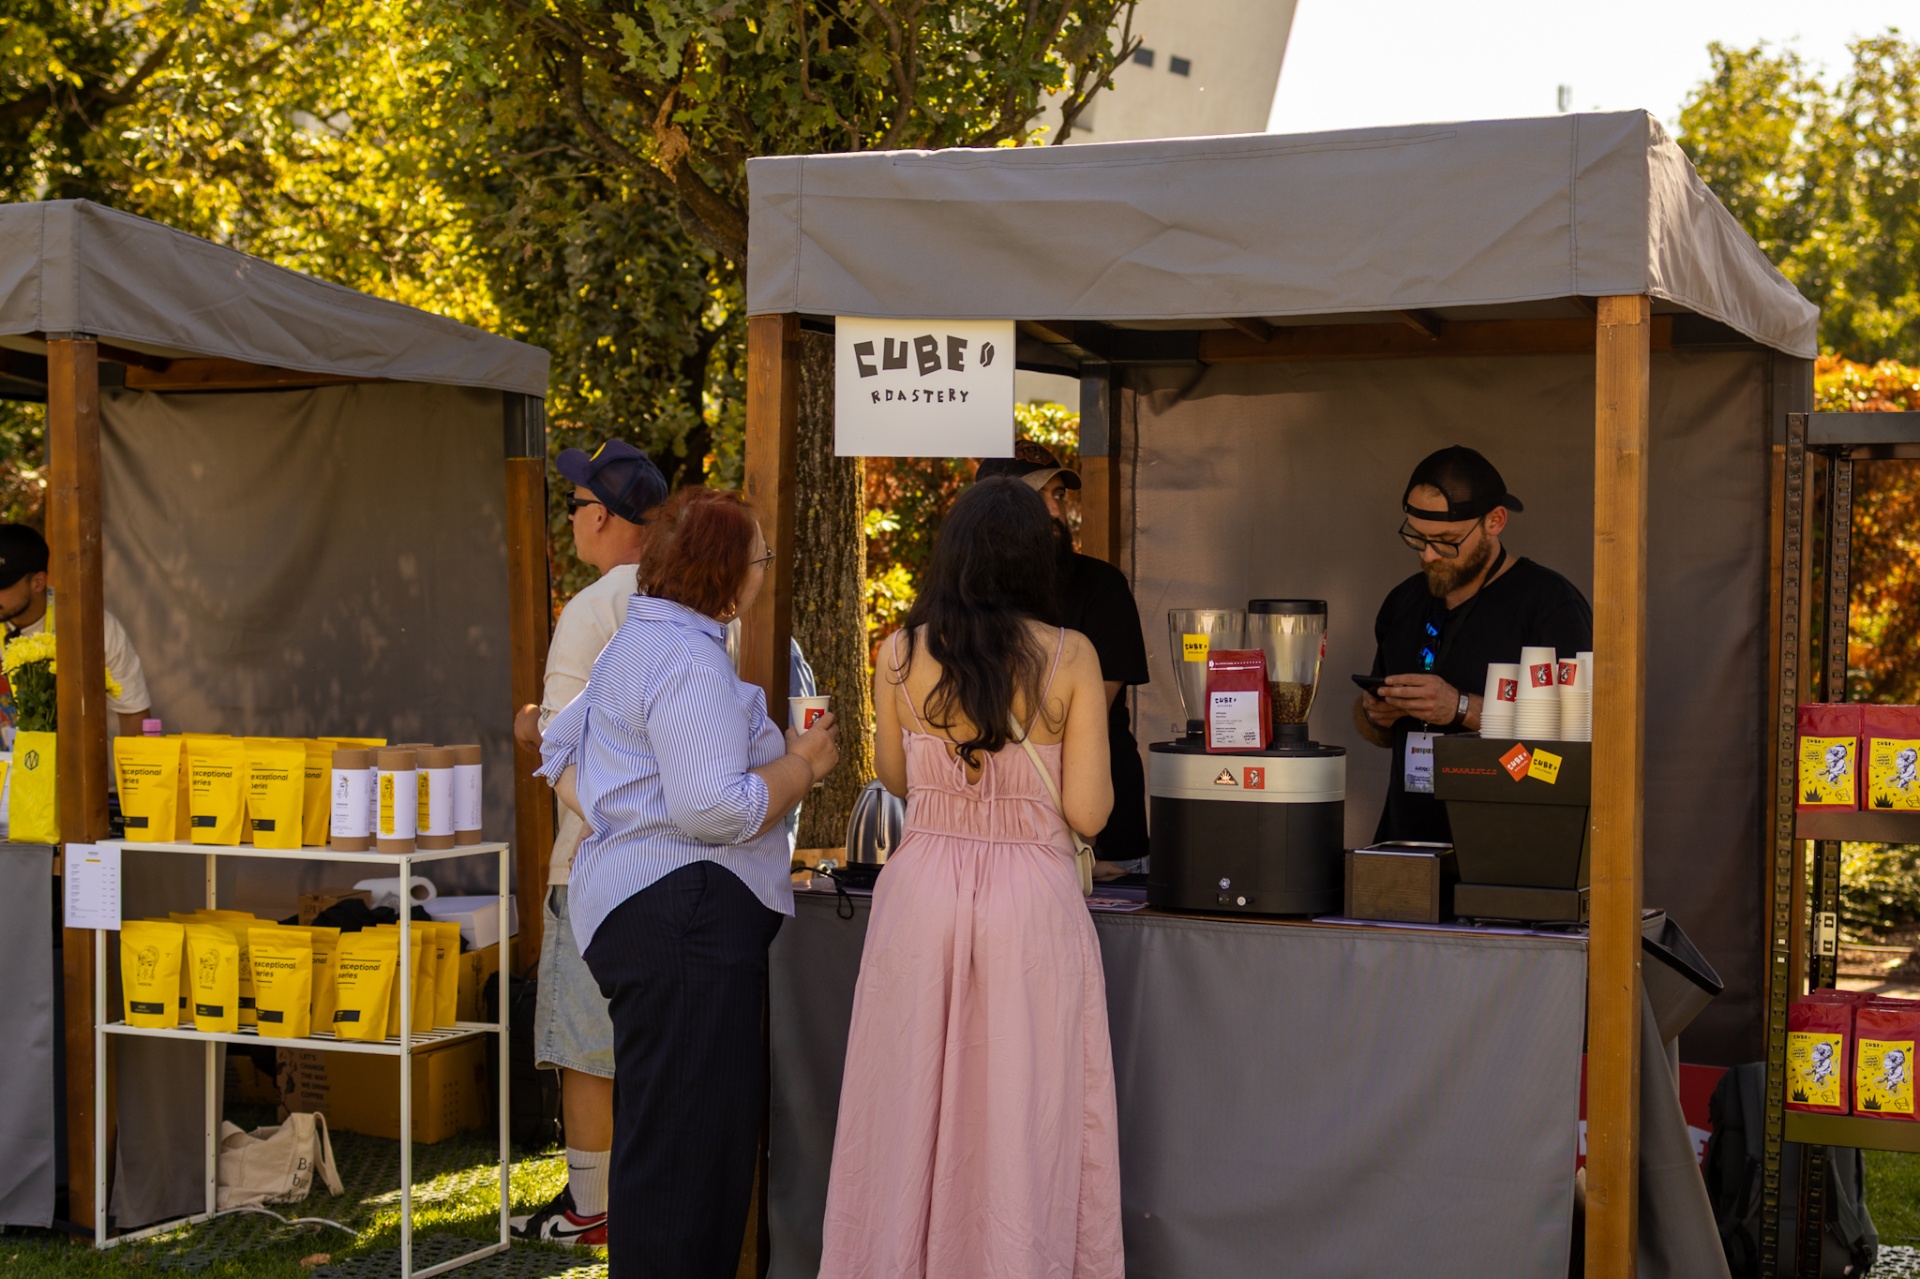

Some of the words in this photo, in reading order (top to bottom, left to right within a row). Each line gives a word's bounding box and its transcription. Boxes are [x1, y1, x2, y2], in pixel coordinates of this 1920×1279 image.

[853, 334, 968, 378] CUBE
[871, 388, 969, 404] ROASTERY
[1506, 753, 1525, 771] CUBE
[1533, 758, 1554, 770] CUBE
